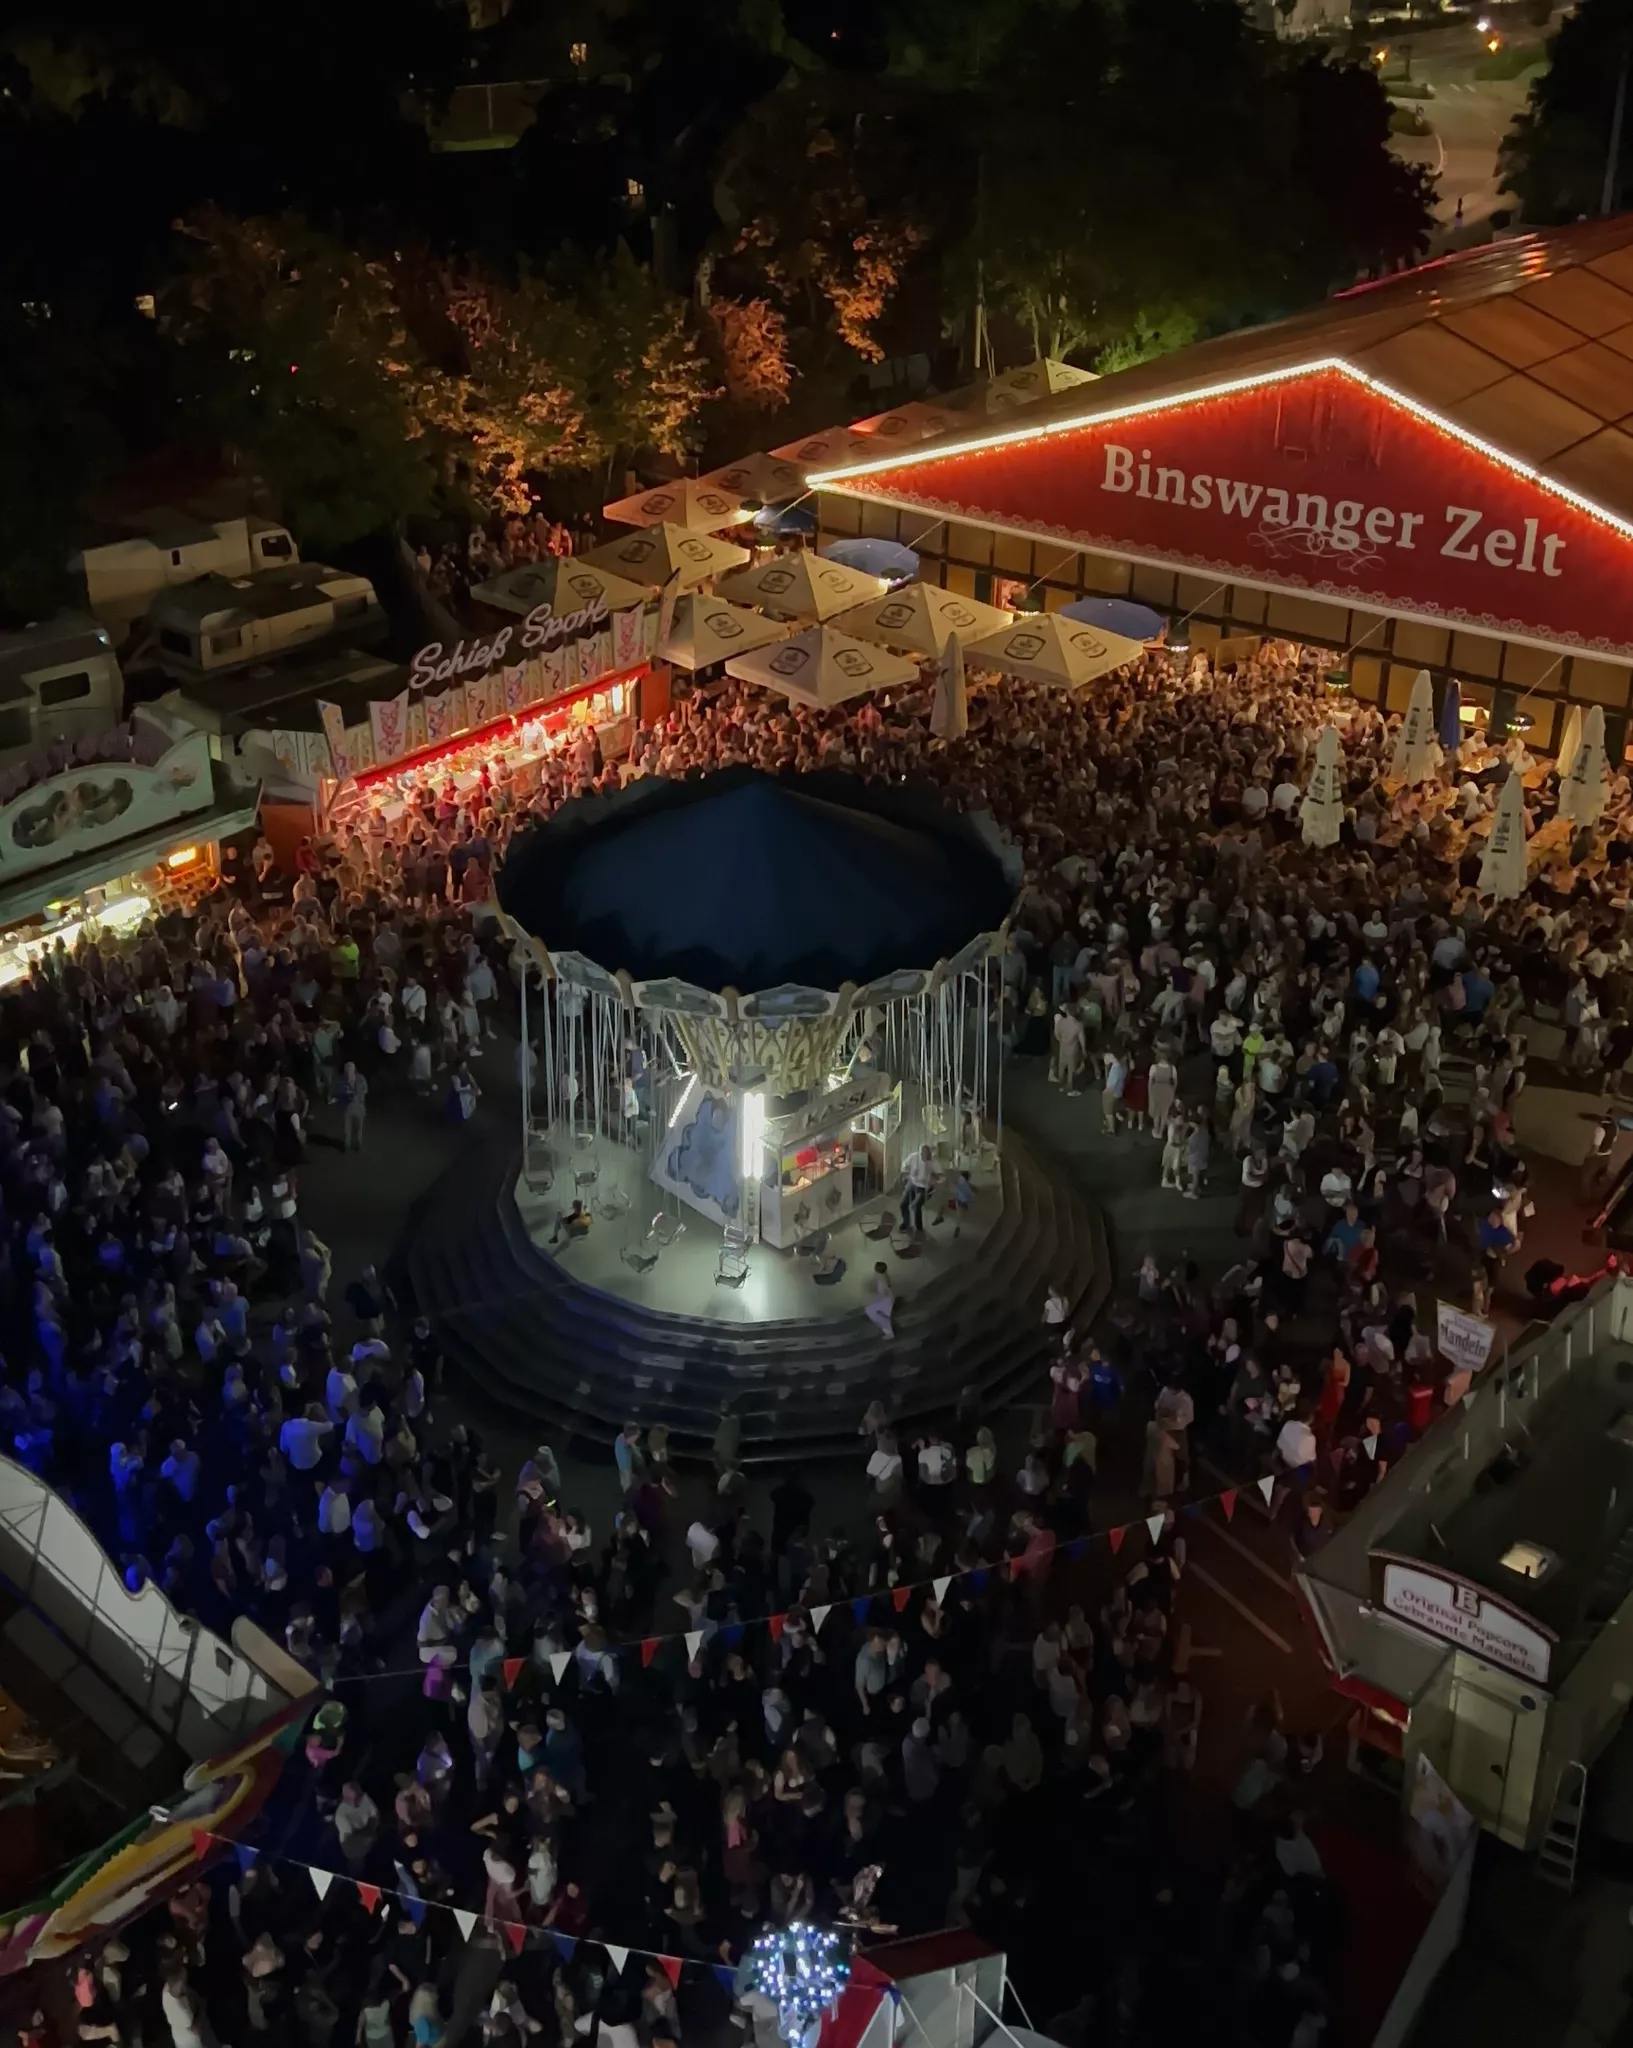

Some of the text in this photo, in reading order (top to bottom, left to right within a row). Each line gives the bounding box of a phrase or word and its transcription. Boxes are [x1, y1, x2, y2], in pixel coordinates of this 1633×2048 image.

[1100, 443, 1566, 577] Binswanger Zelt
[520, 593, 609, 648] Sport
[1440, 1322, 1487, 1358] Mandeln
[1402, 1589, 1529, 1657] Original Popcorn
[1472, 1634, 1537, 1674] Mandeln
